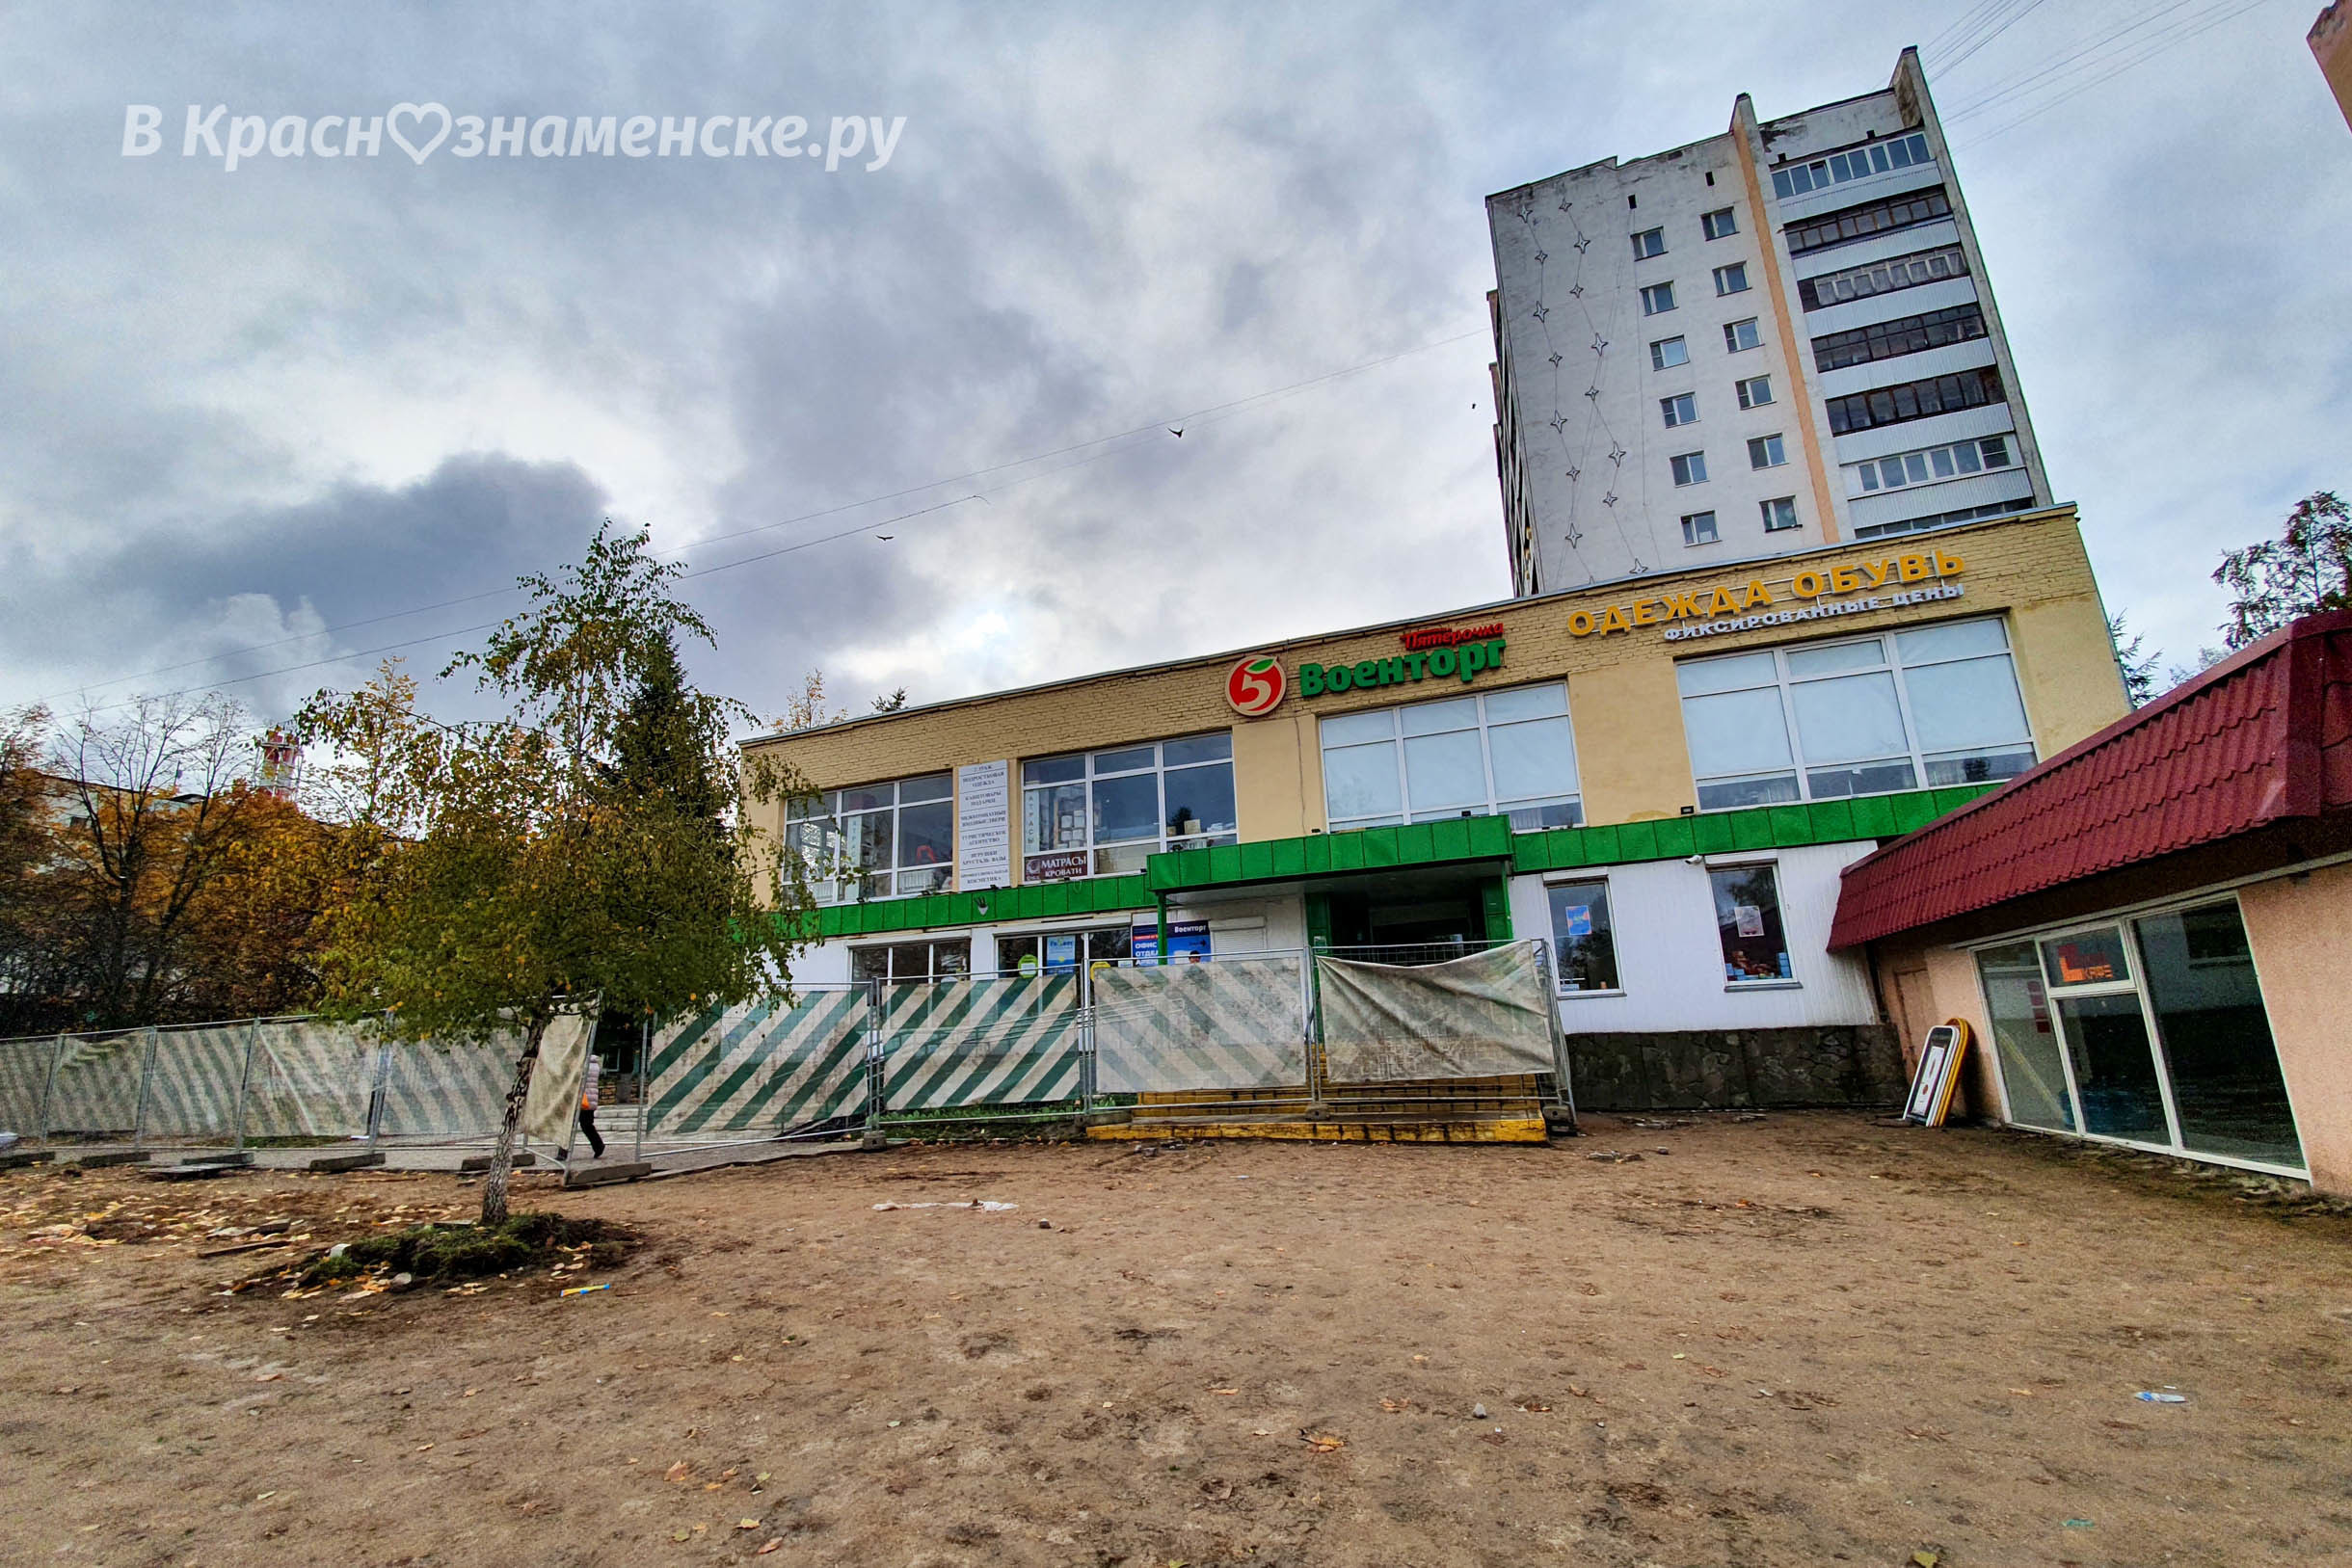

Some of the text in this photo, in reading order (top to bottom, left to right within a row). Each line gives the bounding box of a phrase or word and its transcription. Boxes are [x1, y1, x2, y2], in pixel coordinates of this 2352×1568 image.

[1567, 549, 1965, 636] ОДЕЖДА ОБУВЬ
[1664, 583, 1964, 641] ФИКСИРОВАННЫЕ ЦЕНЫ
[1299, 639, 1507, 698] Военторг
[1041, 855, 1086, 868] МАТРАСЫ
[1045, 868, 1082, 878] КРОВАТИ
